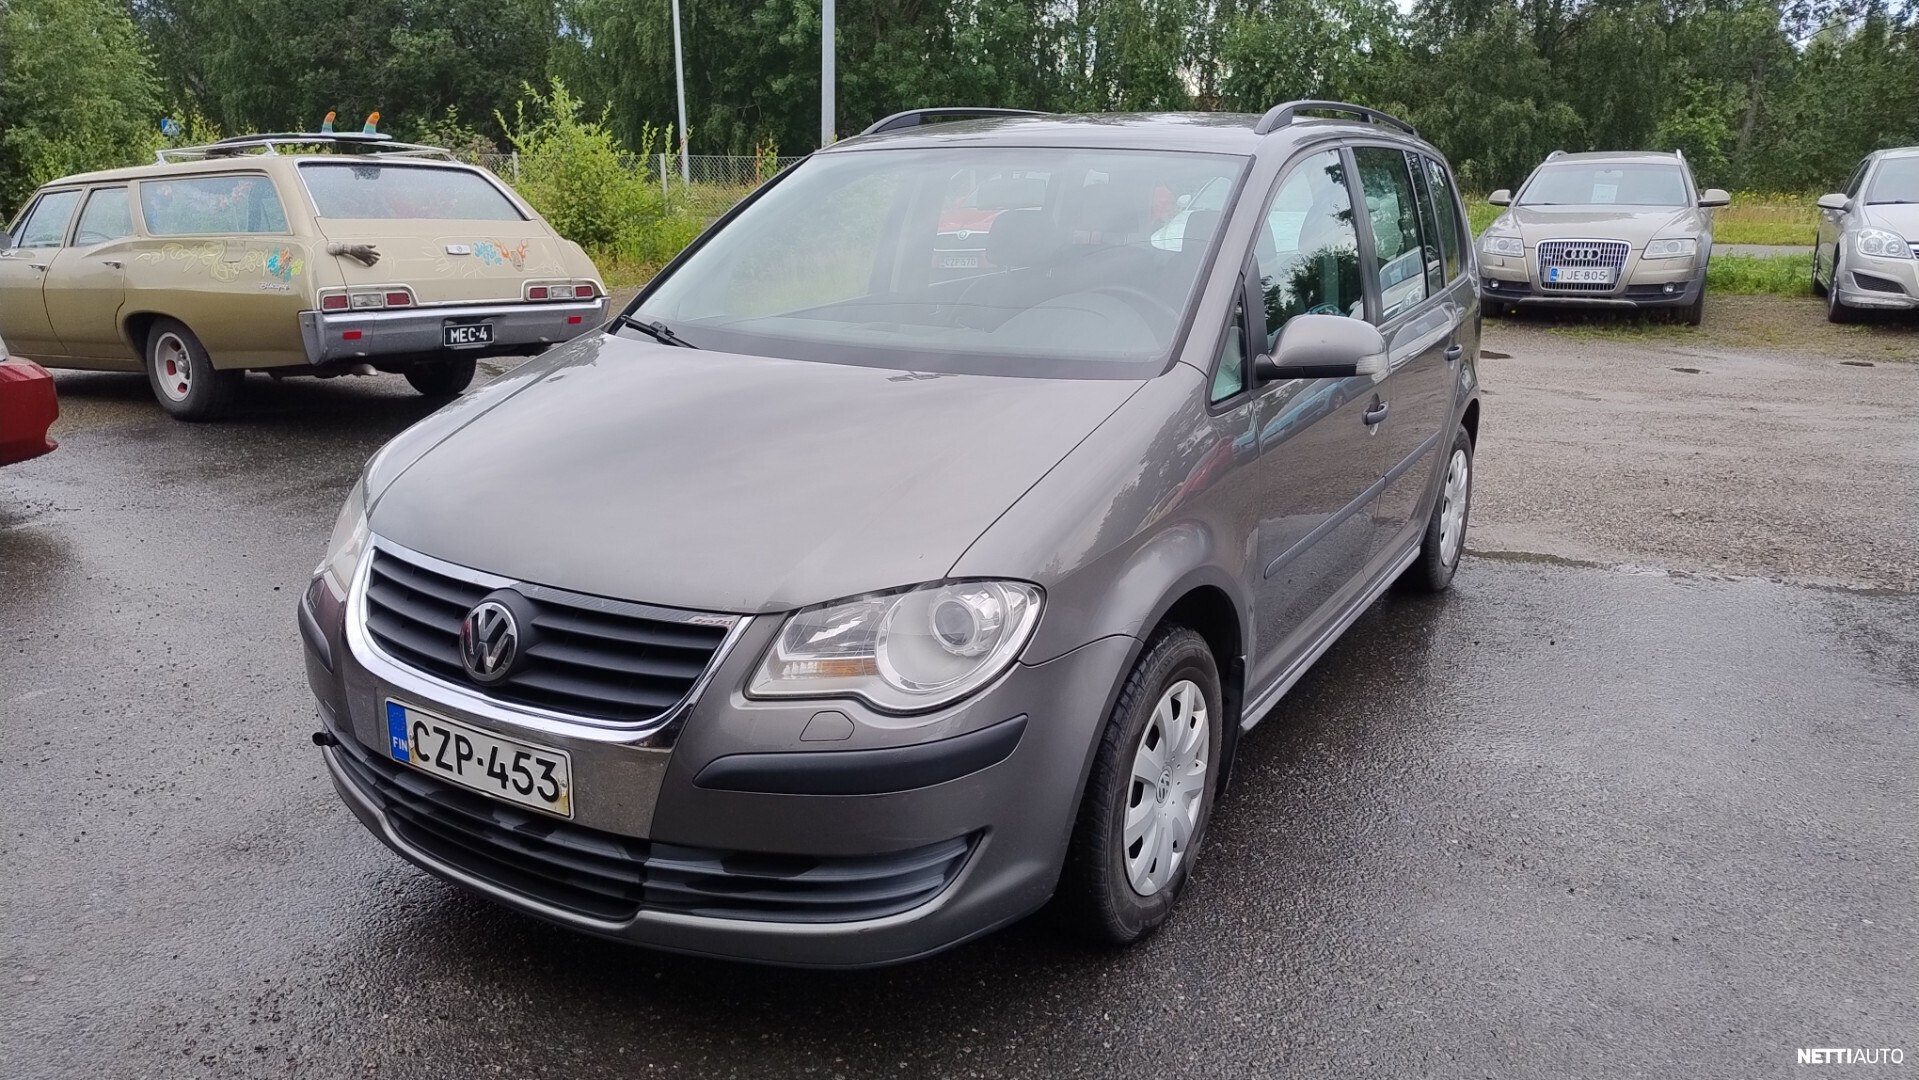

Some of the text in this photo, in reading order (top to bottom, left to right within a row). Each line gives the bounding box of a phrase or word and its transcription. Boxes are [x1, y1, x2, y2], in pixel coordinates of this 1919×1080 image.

[451, 327, 488, 343] MEC-4
[393, 736, 409, 752] FIN
[412, 720, 560, 803] CZP-453
